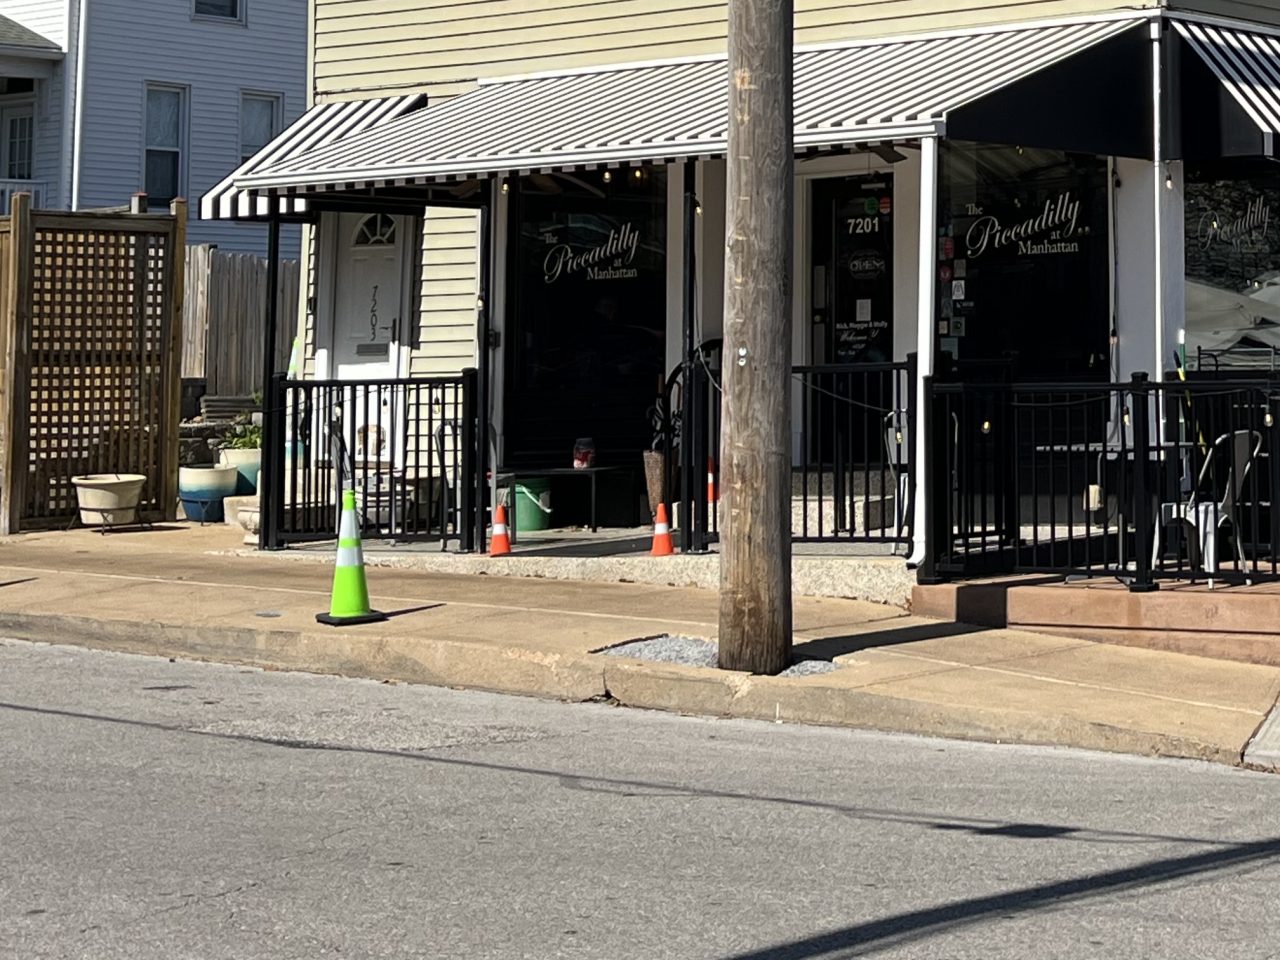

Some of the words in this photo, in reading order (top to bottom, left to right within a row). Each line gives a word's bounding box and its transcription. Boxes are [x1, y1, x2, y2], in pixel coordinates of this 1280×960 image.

[965, 203, 983, 215] The
[847, 217, 880, 234] 7201
[965, 191, 1080, 259] Piccadilly
[543, 232, 559, 244] The
[1050, 230, 1061, 240] at
[543, 222, 640, 284] Piccadilly
[1018, 240, 1079, 255] Manhattan
[613, 257, 623, 268] at
[586, 266, 638, 280] Manhattan
[370, 284, 379, 342] 7203
